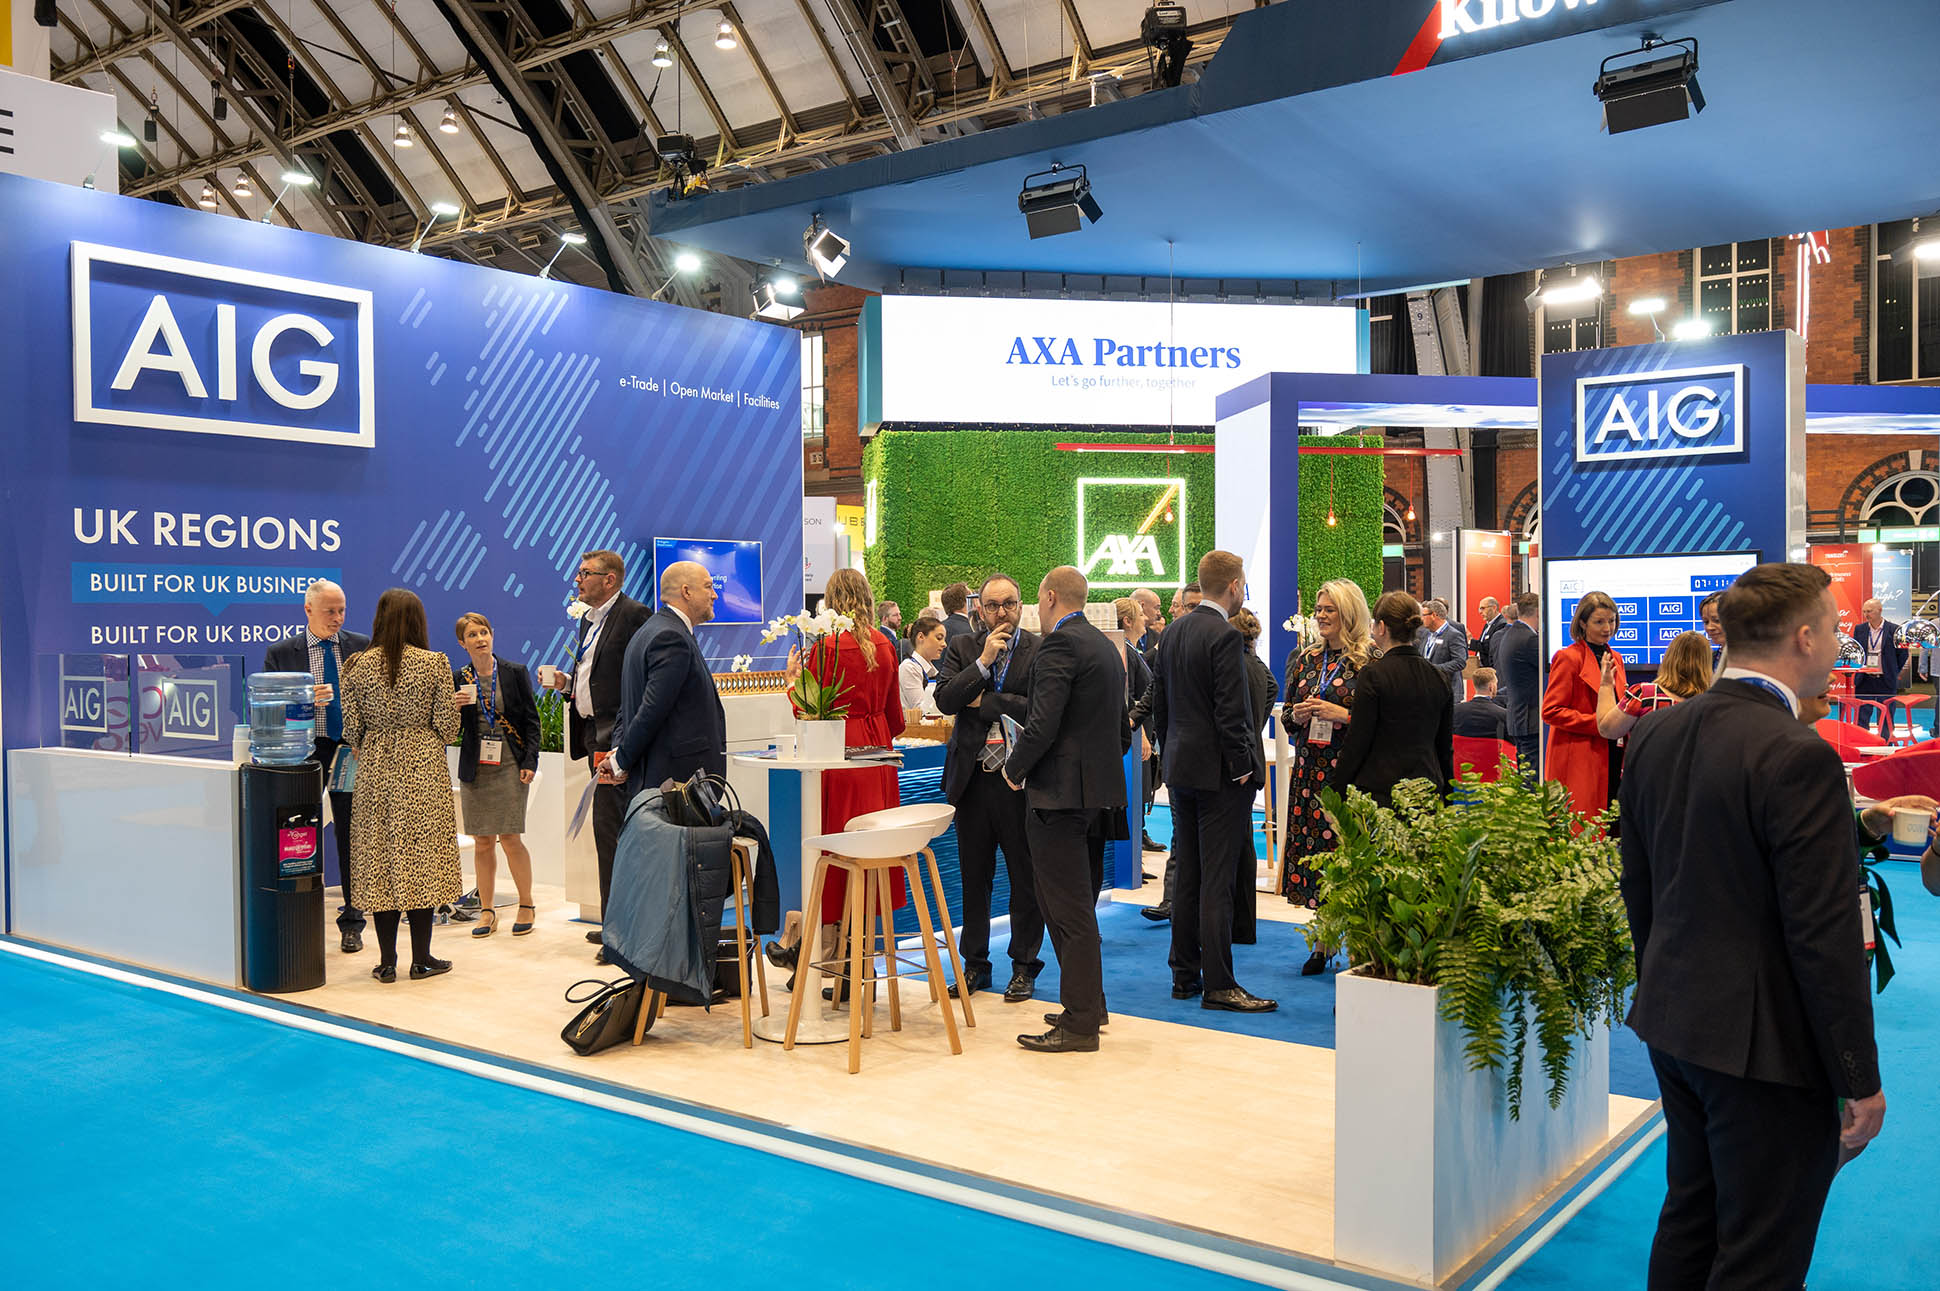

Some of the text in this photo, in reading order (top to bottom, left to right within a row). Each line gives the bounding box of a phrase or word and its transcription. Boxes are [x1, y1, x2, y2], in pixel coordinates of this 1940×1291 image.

[110, 294, 339, 410] AIG
[1006, 336, 1241, 369] AXA Partners
[619, 375, 780, 410] e-Trade Open Market Facilities
[1051, 375, 1196, 391] Let's go further, together
[1594, 386, 1720, 444] AIG
[73, 508, 341, 552] UK REGIONS
[1083, 534, 1166, 575] AXA
[90, 573, 147, 592] BUILT
[153, 574, 196, 593] FOR
[202, 576, 231, 593] UK
[1662, 604, 1680, 613] AIG
[91, 626, 149, 645] BUILT
[156, 625, 199, 644] FOR
[205, 625, 234, 643] UK
[1617, 630, 1635, 639] AIG
[64, 687, 101, 721] AIG
[168, 691, 211, 728] AIG
